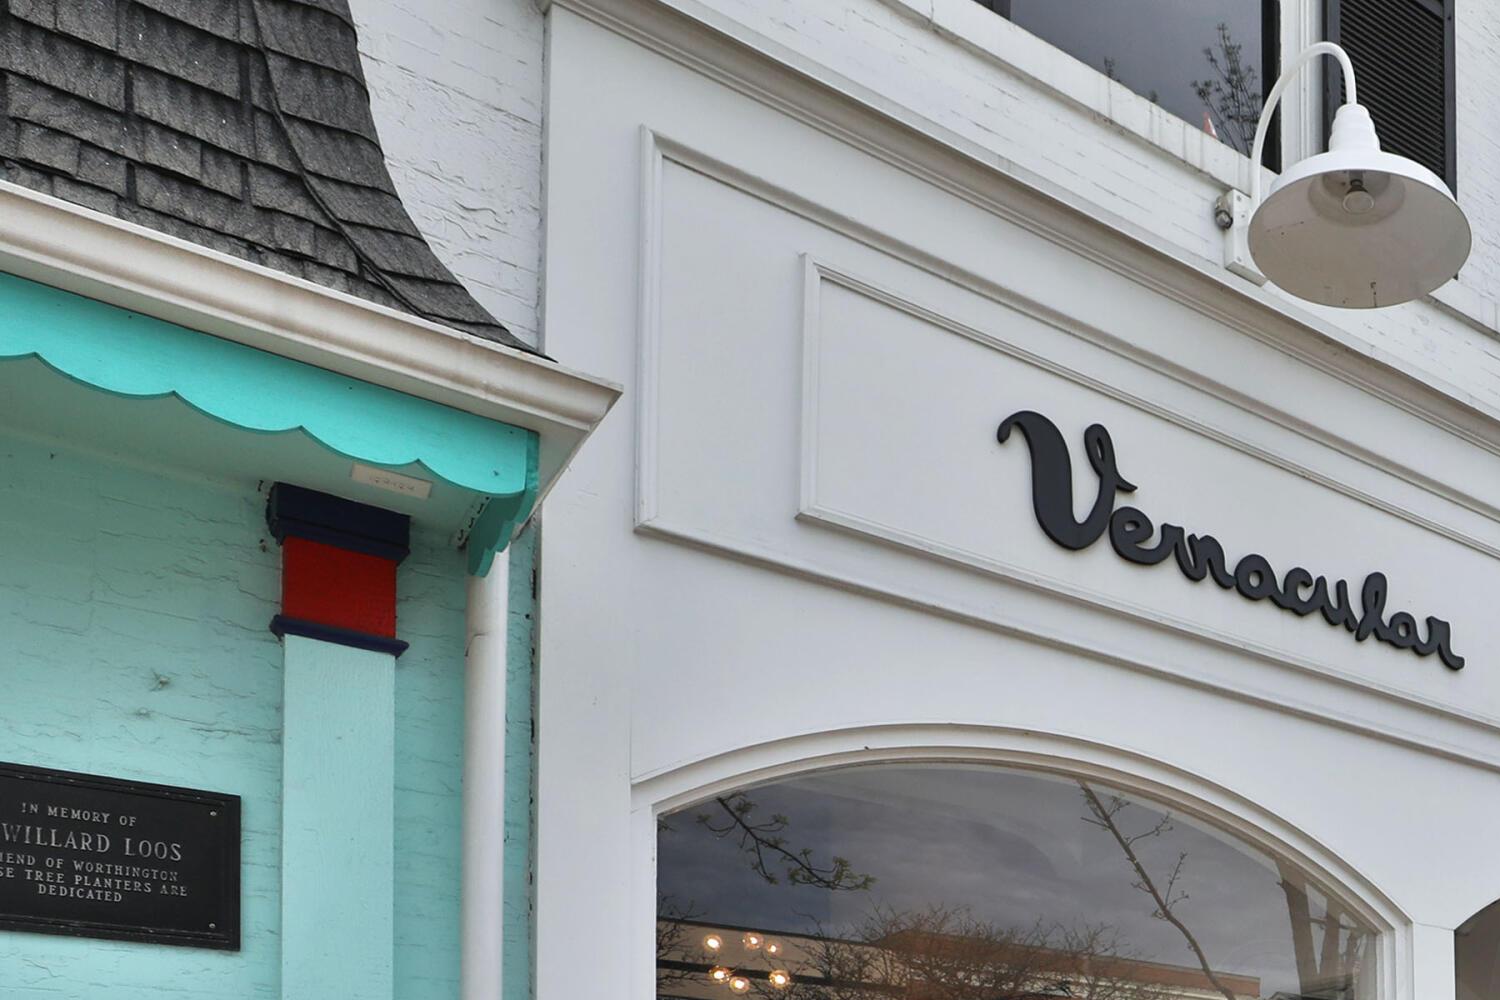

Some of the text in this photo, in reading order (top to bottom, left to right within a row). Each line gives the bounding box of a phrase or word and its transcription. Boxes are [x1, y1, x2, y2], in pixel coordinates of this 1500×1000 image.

[996, 409, 1465, 671] Vernacular
[21, 802, 137, 827] IN MEMORY OF
[1, 823, 182, 862] WILLARD LOOS
[24, 869, 65, 884] TREE
[74, 874, 152, 893] PLANTERS
[160, 884, 188, 897] ARE
[46, 858, 64, 869] OF
[73, 860, 178, 882] WORTHINGTON
[38, 884, 123, 902] DEDICATED
